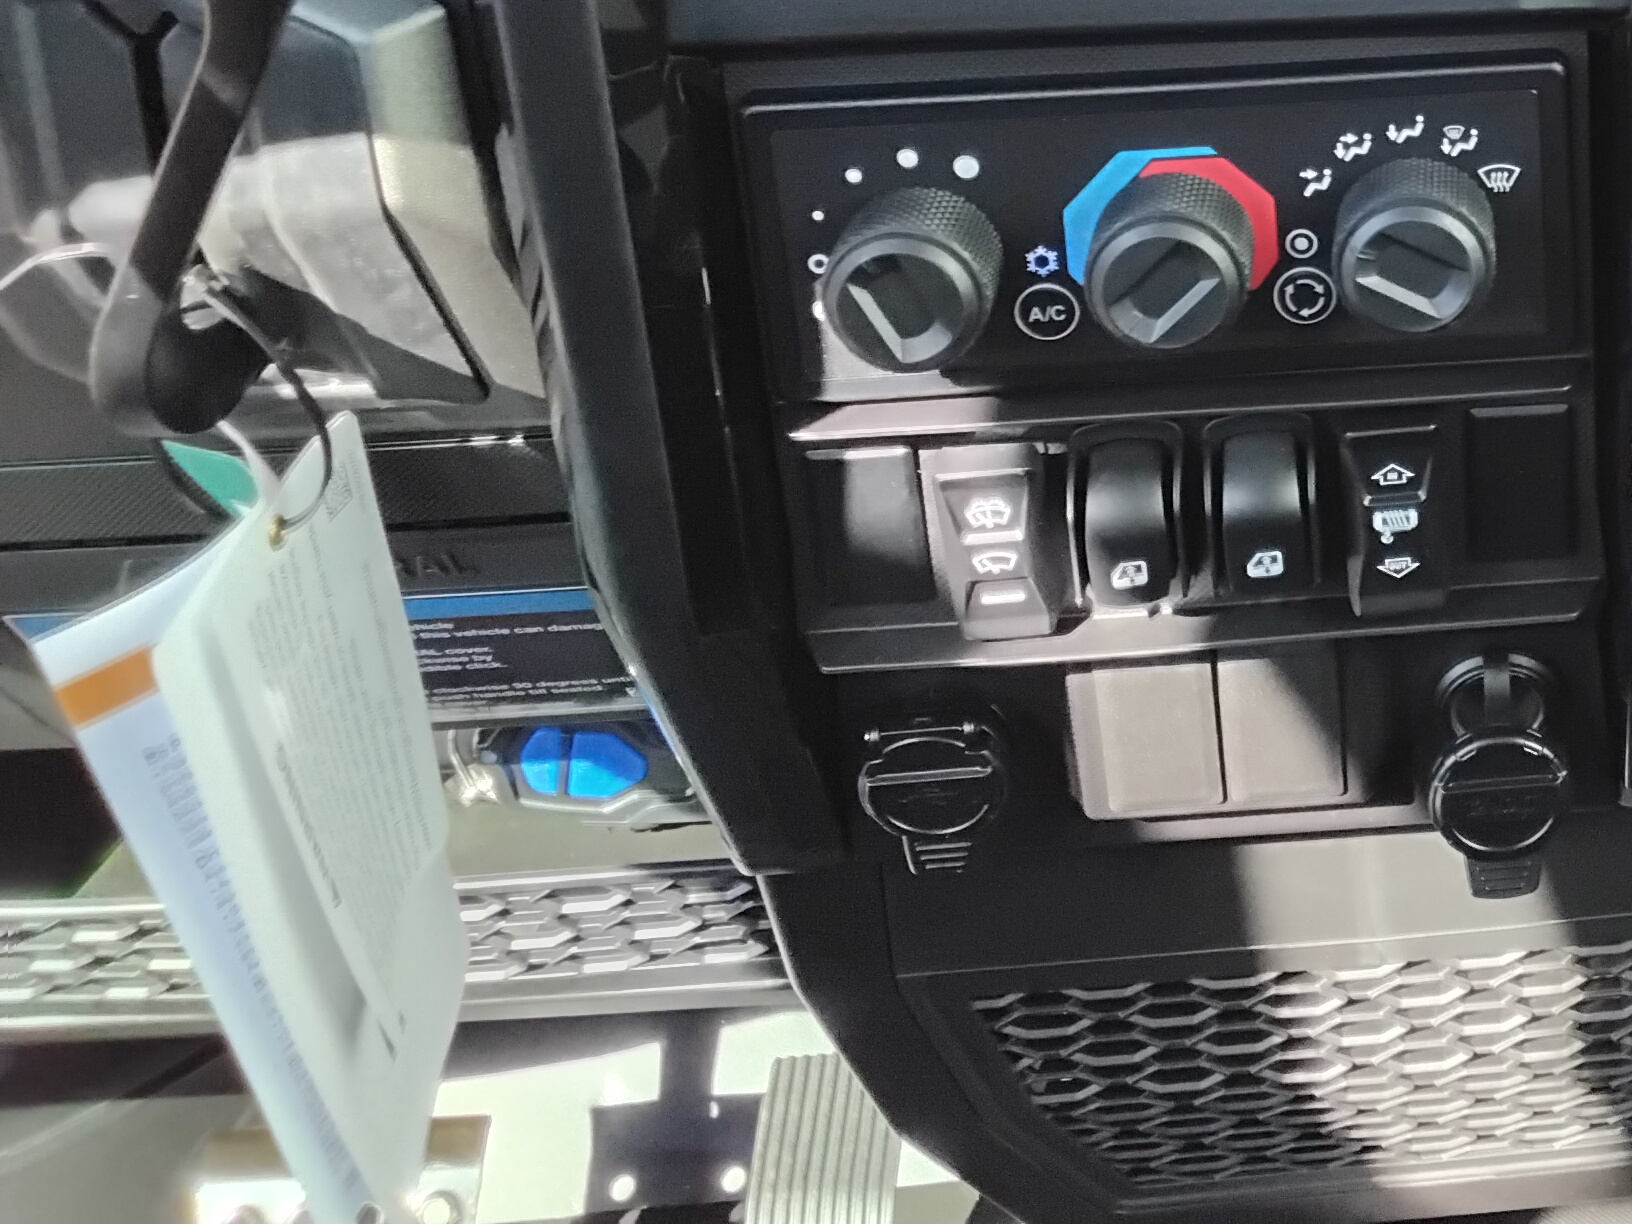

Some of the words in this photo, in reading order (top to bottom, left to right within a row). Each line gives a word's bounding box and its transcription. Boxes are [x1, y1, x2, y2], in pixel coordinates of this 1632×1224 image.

[1028, 305, 1067, 323] A/C
[453, 628, 511, 637] vehicle
[513, 626, 545, 634] can
[535, 678, 599, 689] degrees
